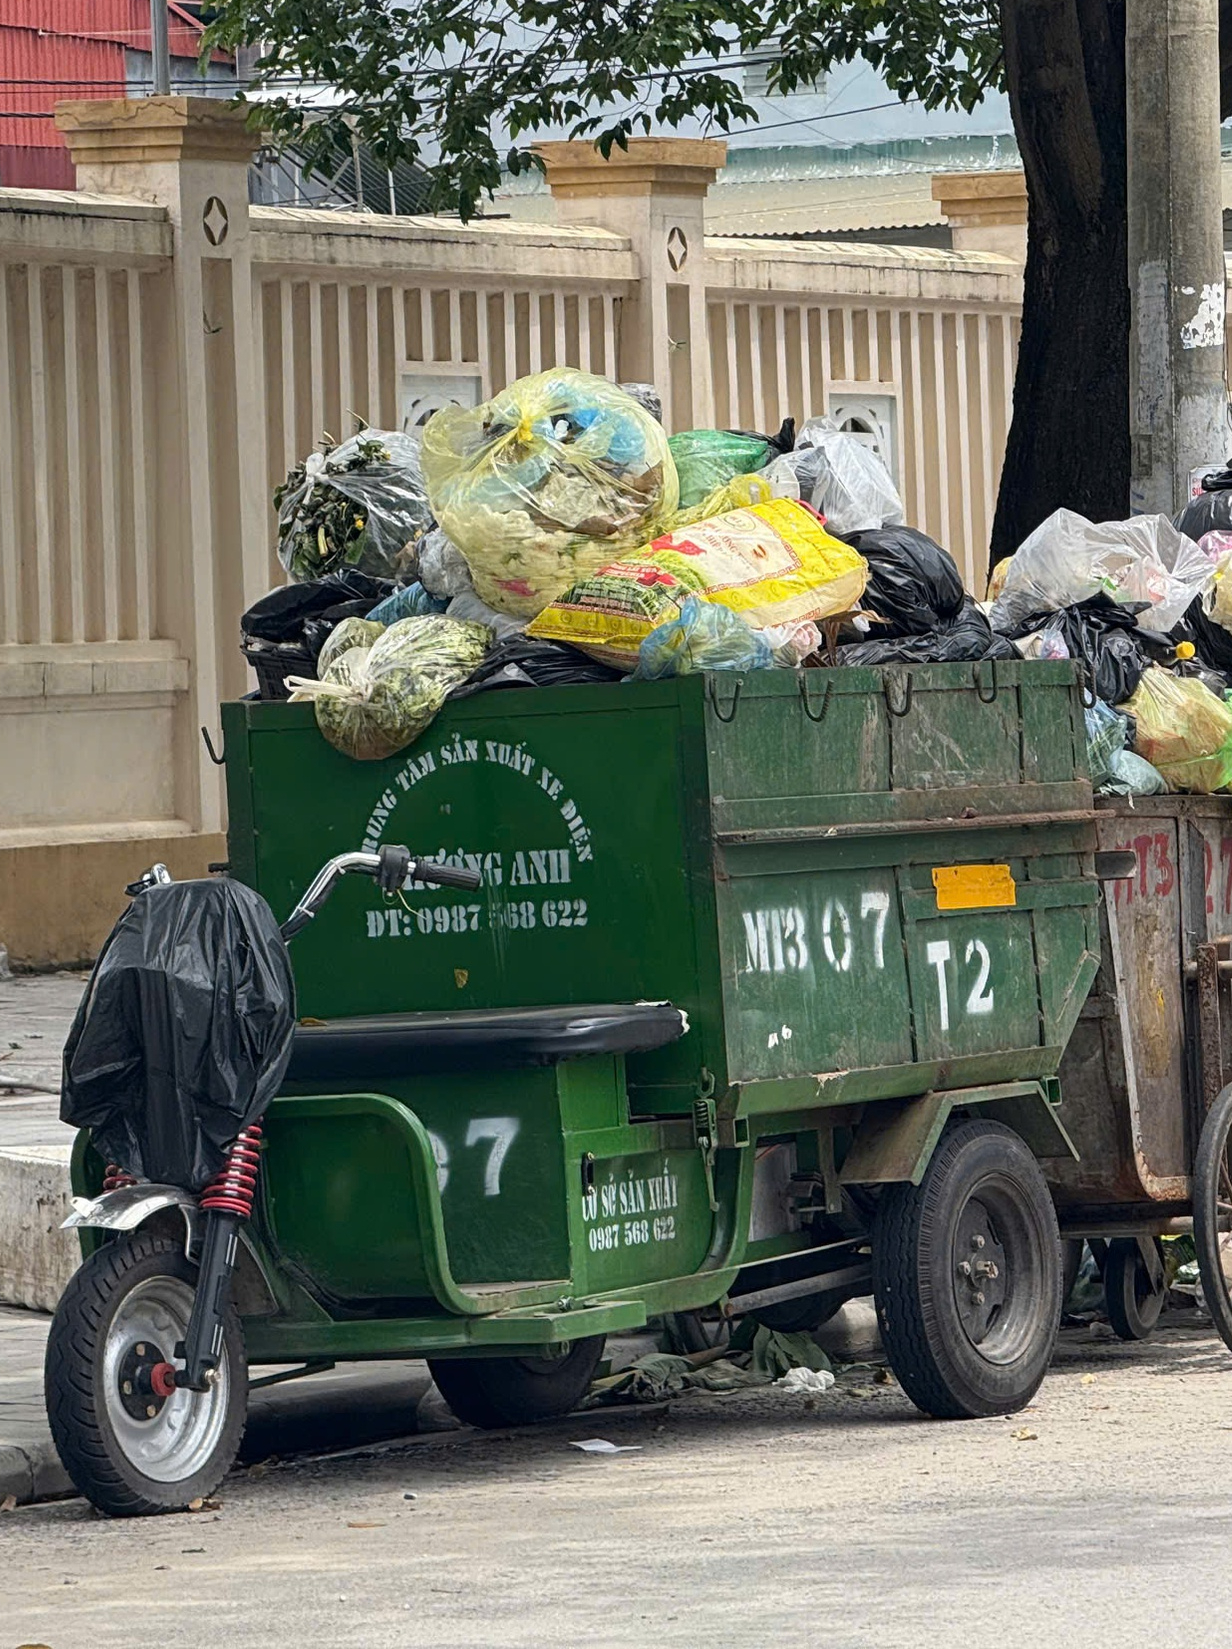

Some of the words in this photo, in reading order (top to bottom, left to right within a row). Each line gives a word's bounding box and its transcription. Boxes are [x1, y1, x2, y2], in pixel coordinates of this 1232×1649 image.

[361, 788, 398, 855] RUNG
[395, 751, 437, 791] TÂM
[440, 732, 478, 766] SẢN
[485, 741, 535, 776] XUẤT
[536, 767, 564, 801] XE
[510, 849, 572, 886] ANH
[417, 904, 481, 935] 0987
[541, 898, 589, 928] 622
[619, 1169, 646, 1215] SẢN
[647, 1157, 679, 1211] XUẤT
[588, 1224, 620, 1252] 0987
[624, 1220, 649, 1246] 568
[653, 1215, 676, 1242] 622
